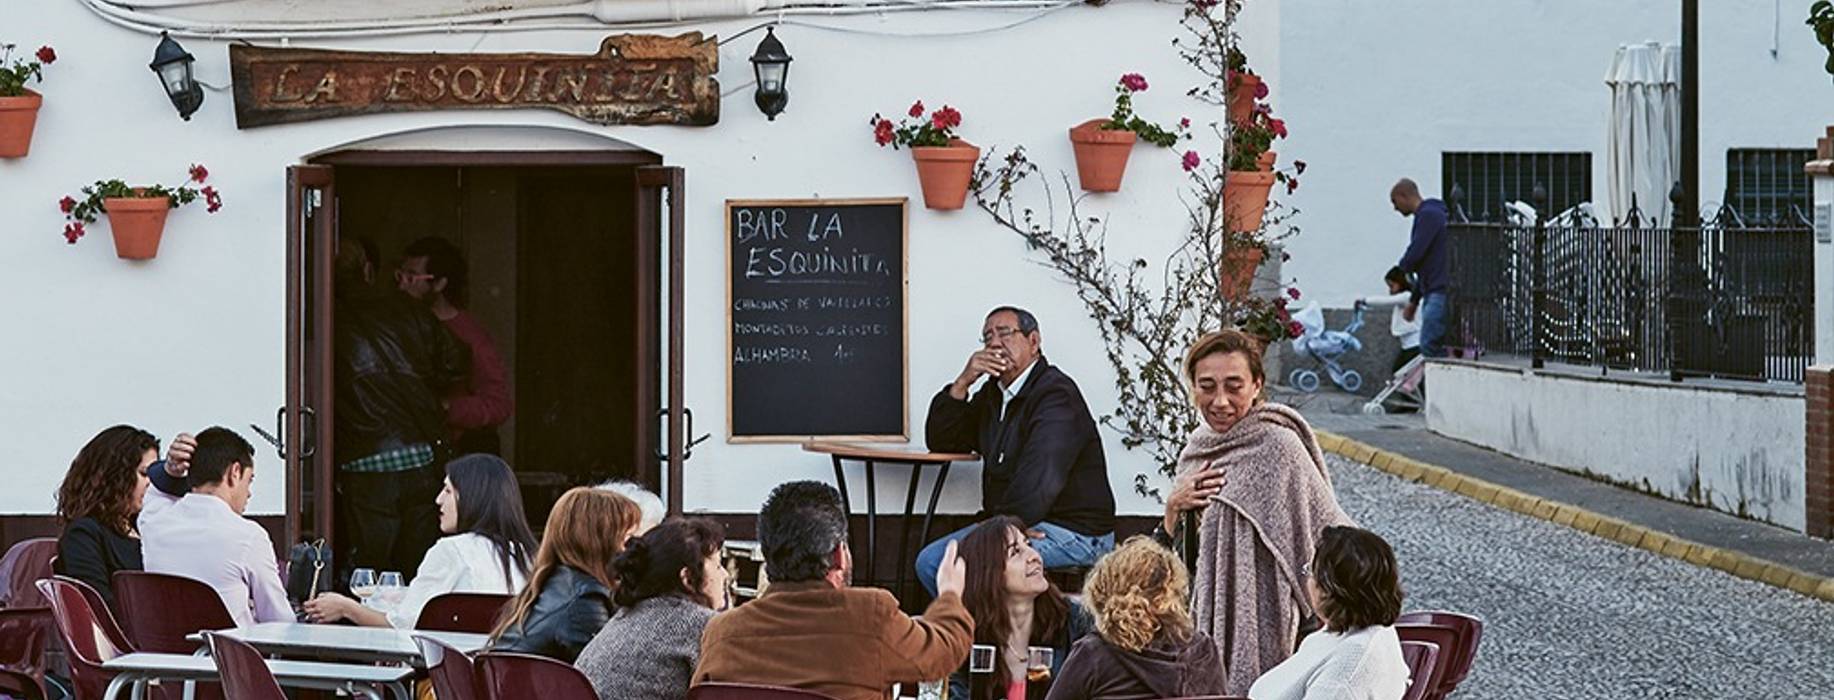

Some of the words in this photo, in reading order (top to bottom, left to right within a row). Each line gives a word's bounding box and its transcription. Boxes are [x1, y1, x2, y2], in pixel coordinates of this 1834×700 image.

[272, 63, 338, 101] LA
[385, 60, 682, 102] ESQUINITA
[736, 208, 788, 243] BAR
[807, 212, 843, 241] LA
